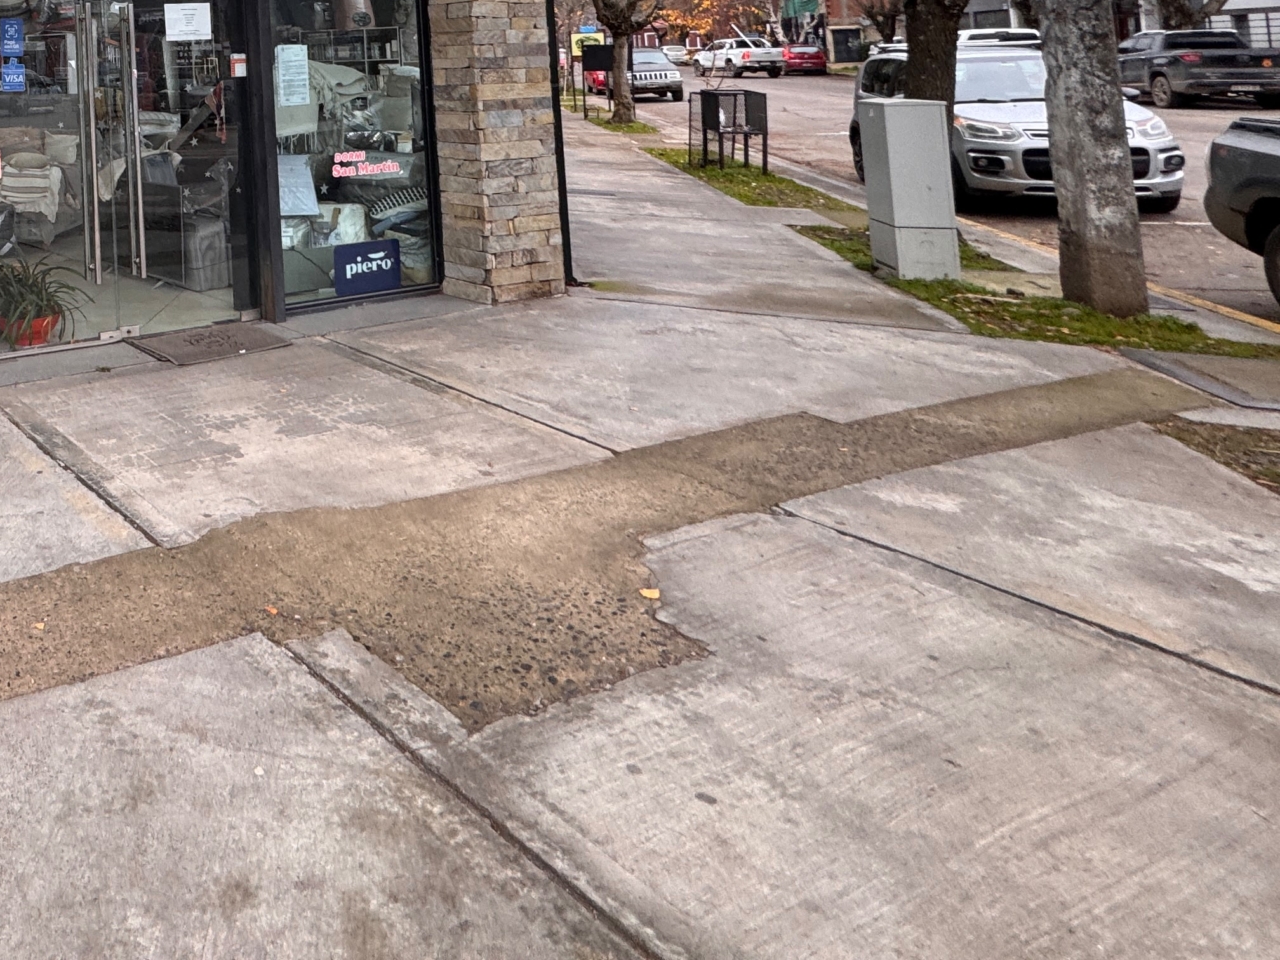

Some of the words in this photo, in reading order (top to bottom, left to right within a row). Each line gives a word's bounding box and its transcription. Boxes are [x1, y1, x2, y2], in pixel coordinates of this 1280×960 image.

[4, 75, 24, 83] VISA
[334, 151, 366, 163] DORMI
[332, 164, 356, 178] San
[345, 256, 391, 279] piero
